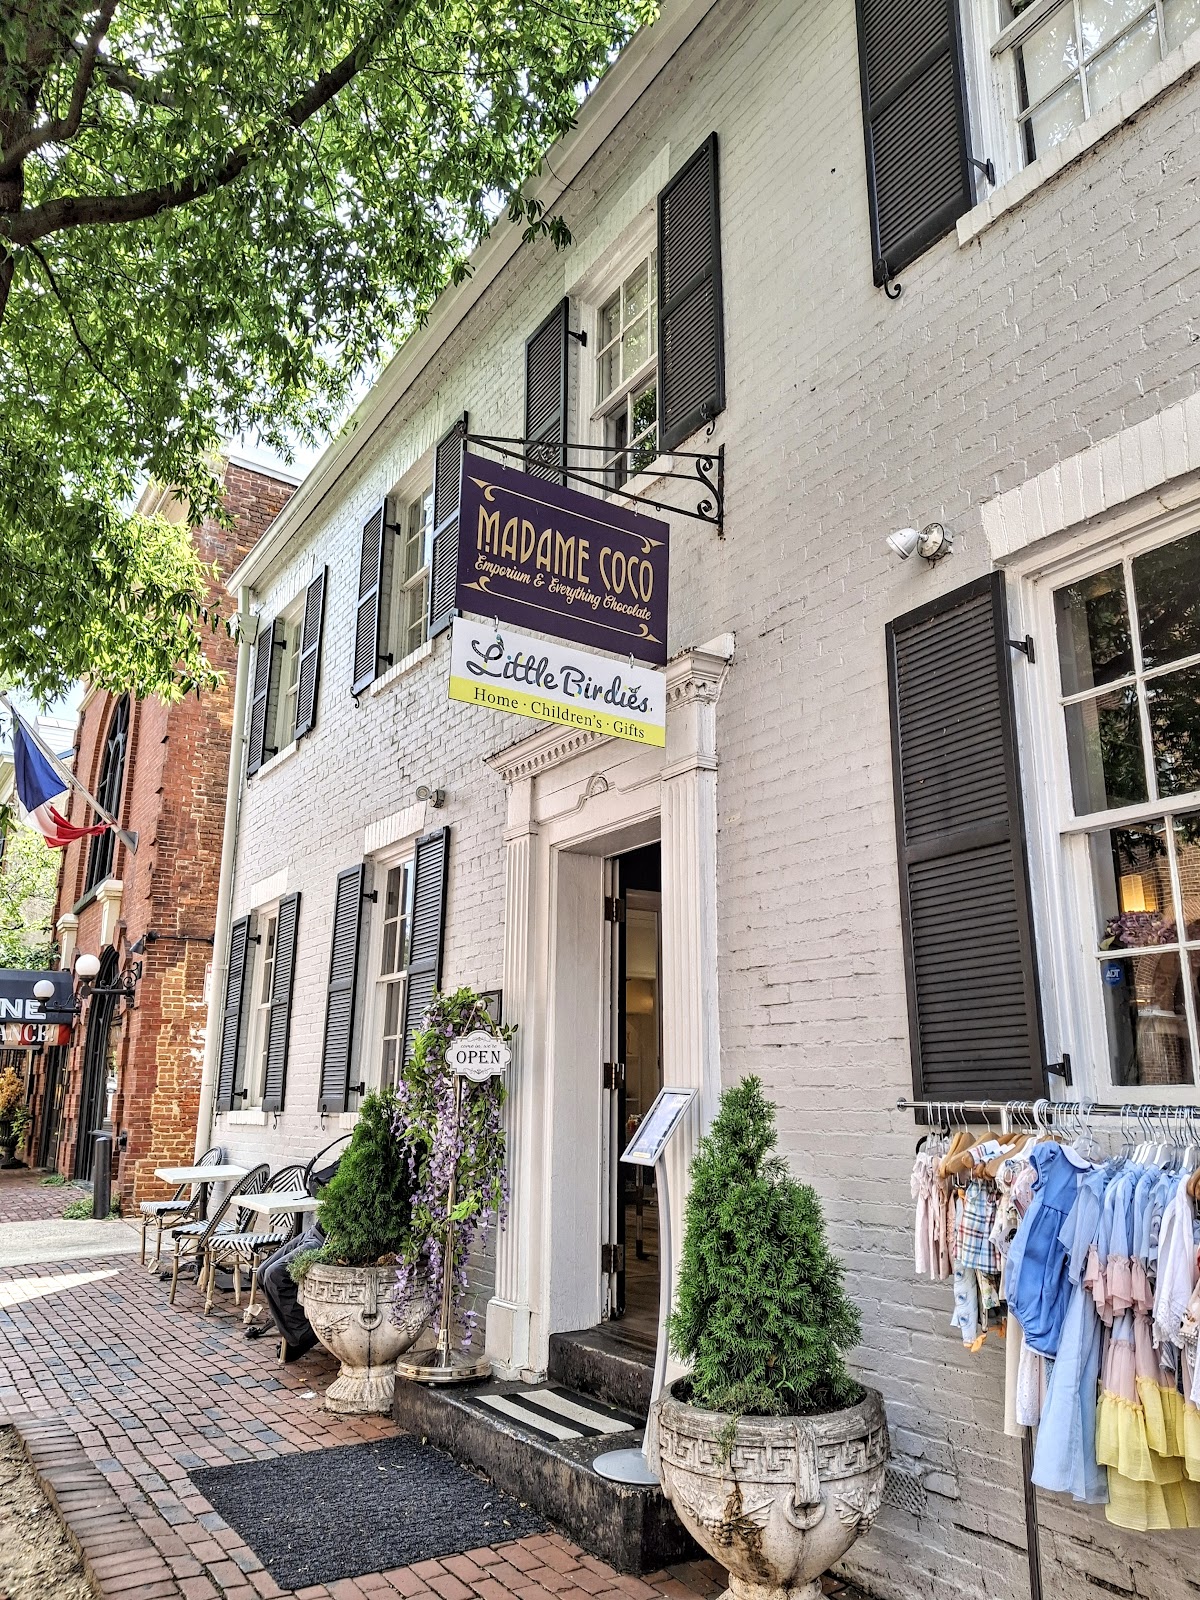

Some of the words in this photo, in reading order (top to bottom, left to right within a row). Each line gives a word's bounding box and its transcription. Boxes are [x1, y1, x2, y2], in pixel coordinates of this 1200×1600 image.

[477, 504, 590, 583] MADAME
[600, 547, 653, 602] COCO
[475, 553, 531, 586] Emporium
[534, 573, 545, 587] &
[548, 575, 602, 610] Everything
[602, 592, 652, 621] Chocolate
[466, 639, 559, 689] Little
[473, 686, 520, 710] Home
[530, 700, 603, 730] Children's
[613, 719, 646, 740] Gifts
[1106, 969, 1120, 977] ADT
[456, 1051, 500, 1064] OPEN
